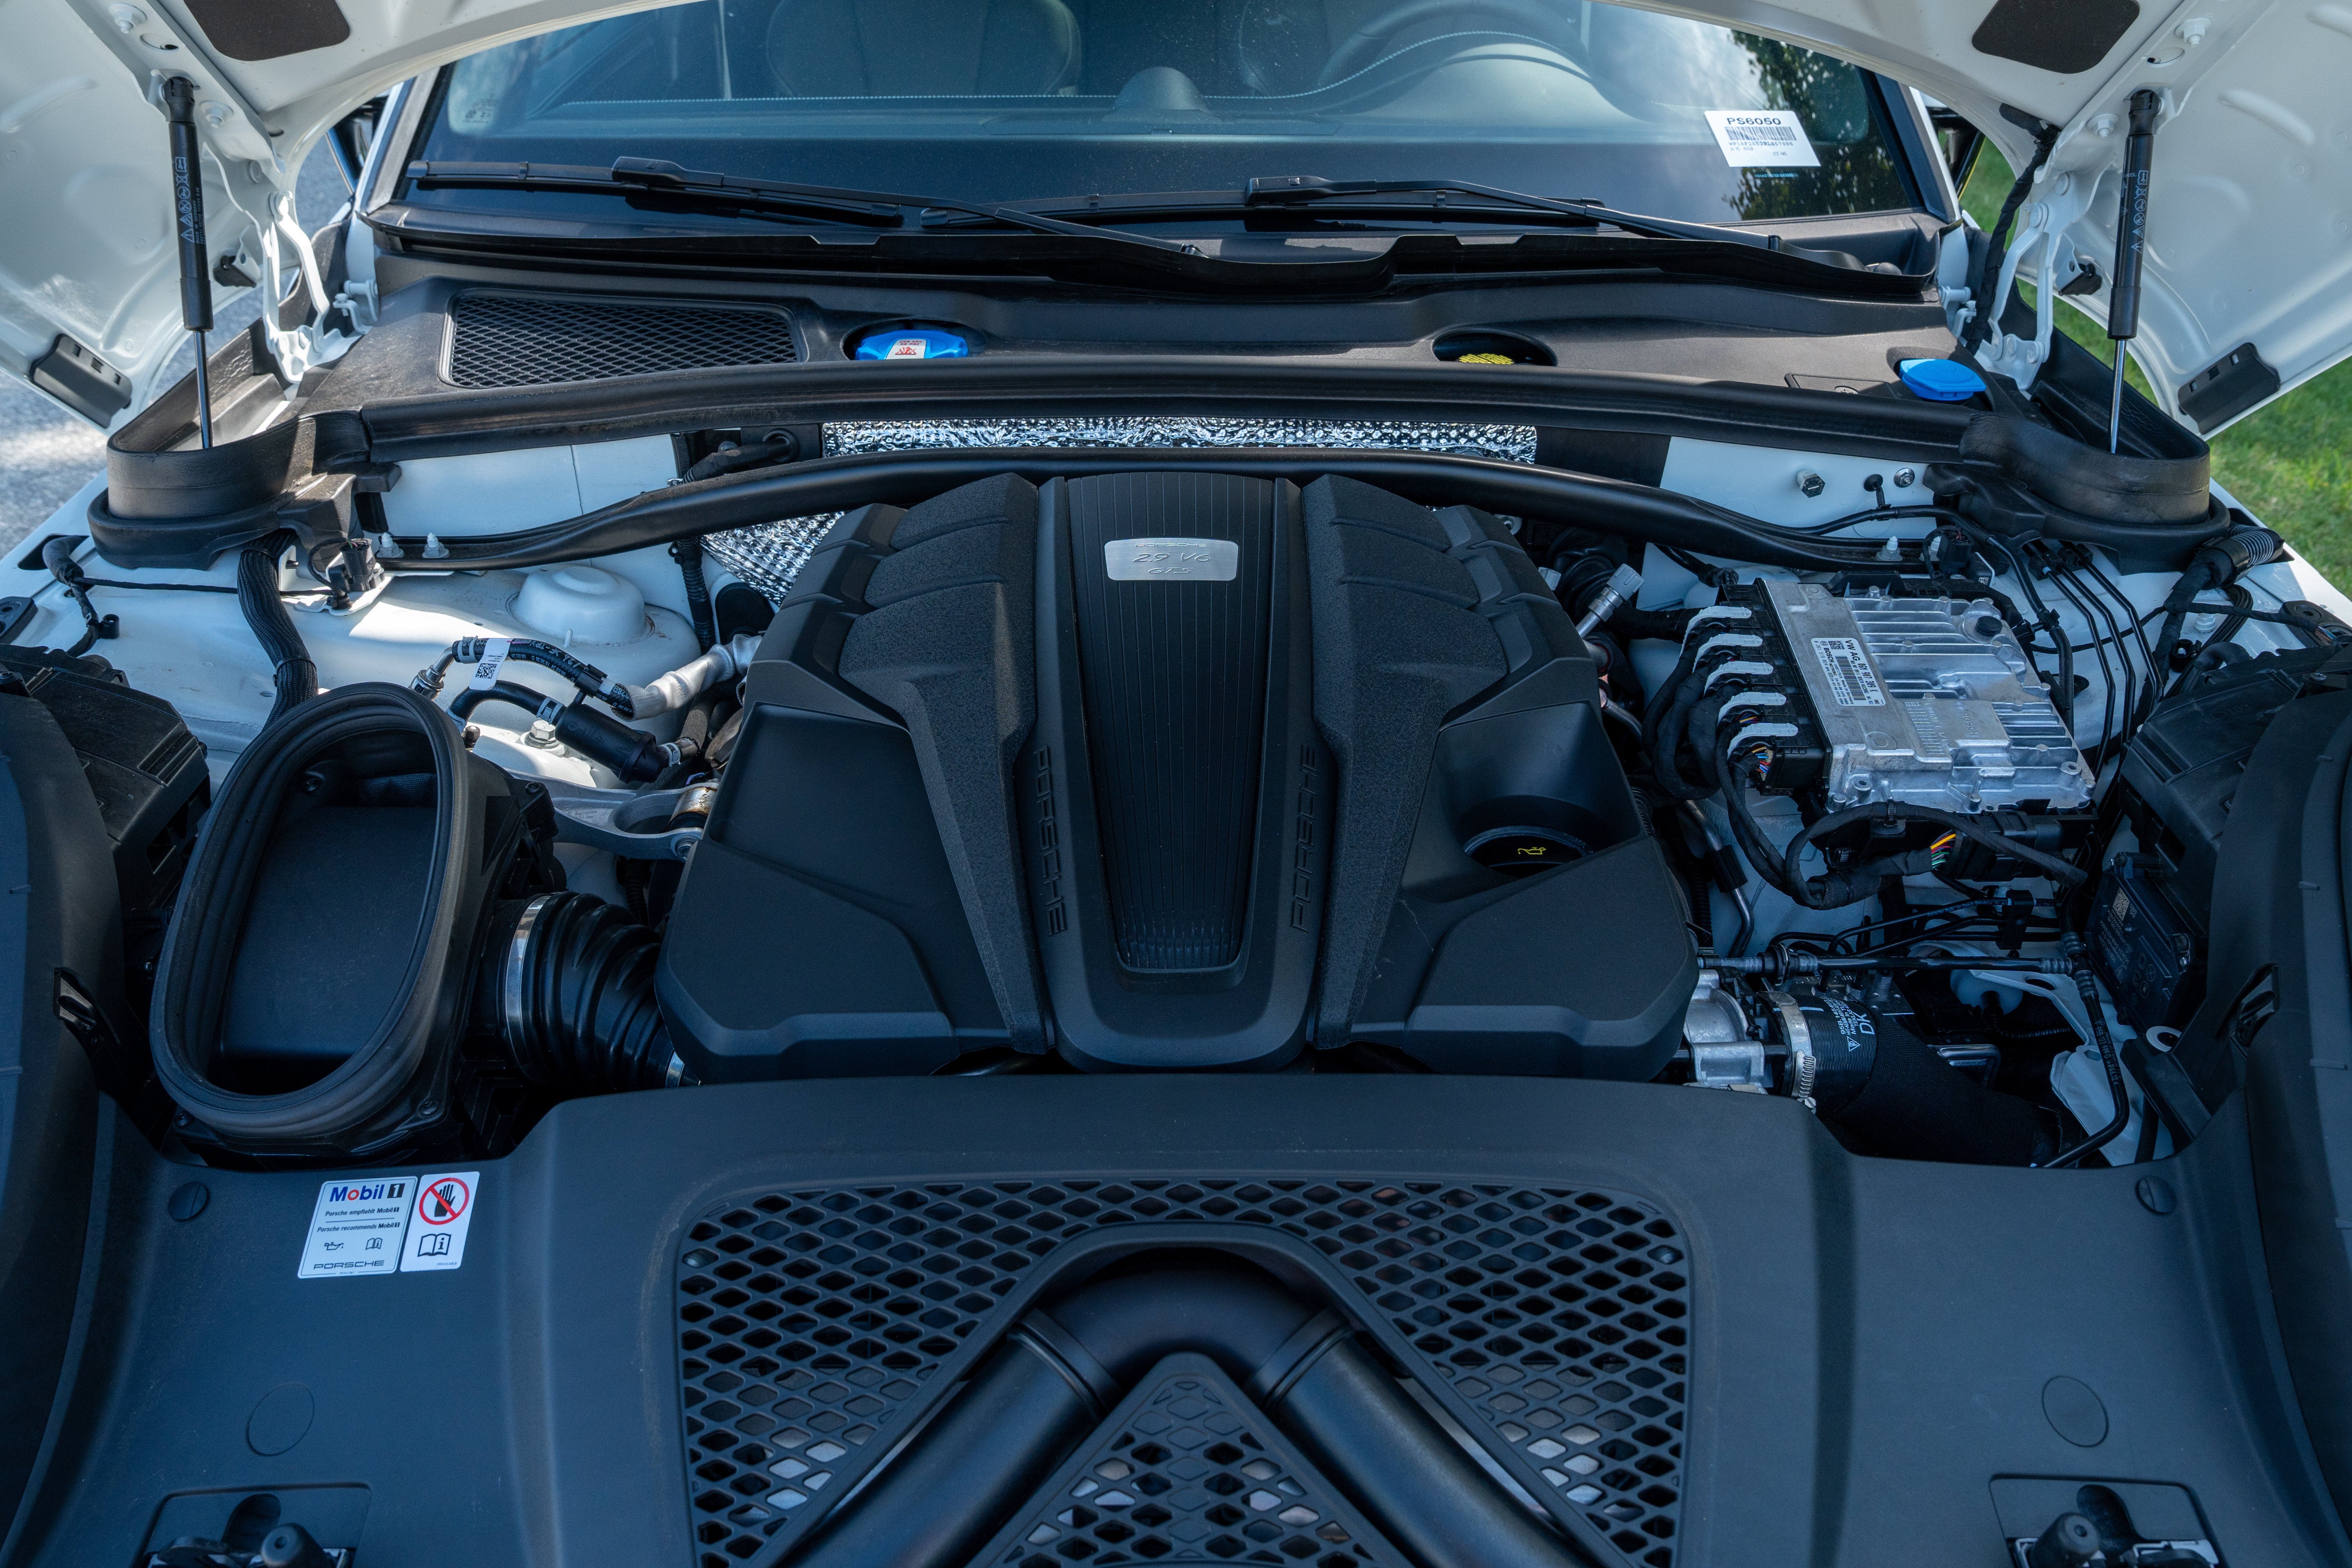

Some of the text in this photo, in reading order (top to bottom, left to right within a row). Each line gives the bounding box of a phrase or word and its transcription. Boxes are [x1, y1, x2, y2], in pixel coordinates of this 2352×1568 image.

[1726, 117, 1781, 125] PS6050
[1133, 553, 1211, 562] 2.9 V6
[1844, 640, 1856, 650] VW
[1823, 648, 1835, 662] BOSCH
[1849, 652, 1861, 661] AG
[1845, 692, 1855, 704] Germany
[1960, 713, 1979, 737] BOSCH
[1033, 745, 1067, 937] PORSCHE
[1291, 744, 1317, 934] PORSCHE
[1848, 1018, 1857, 1034] Made
[1853, 1011, 1875, 1035] DK
[329, 1184, 384, 1202] Mobil
[314, 1260, 385, 1270] PORSCHE
